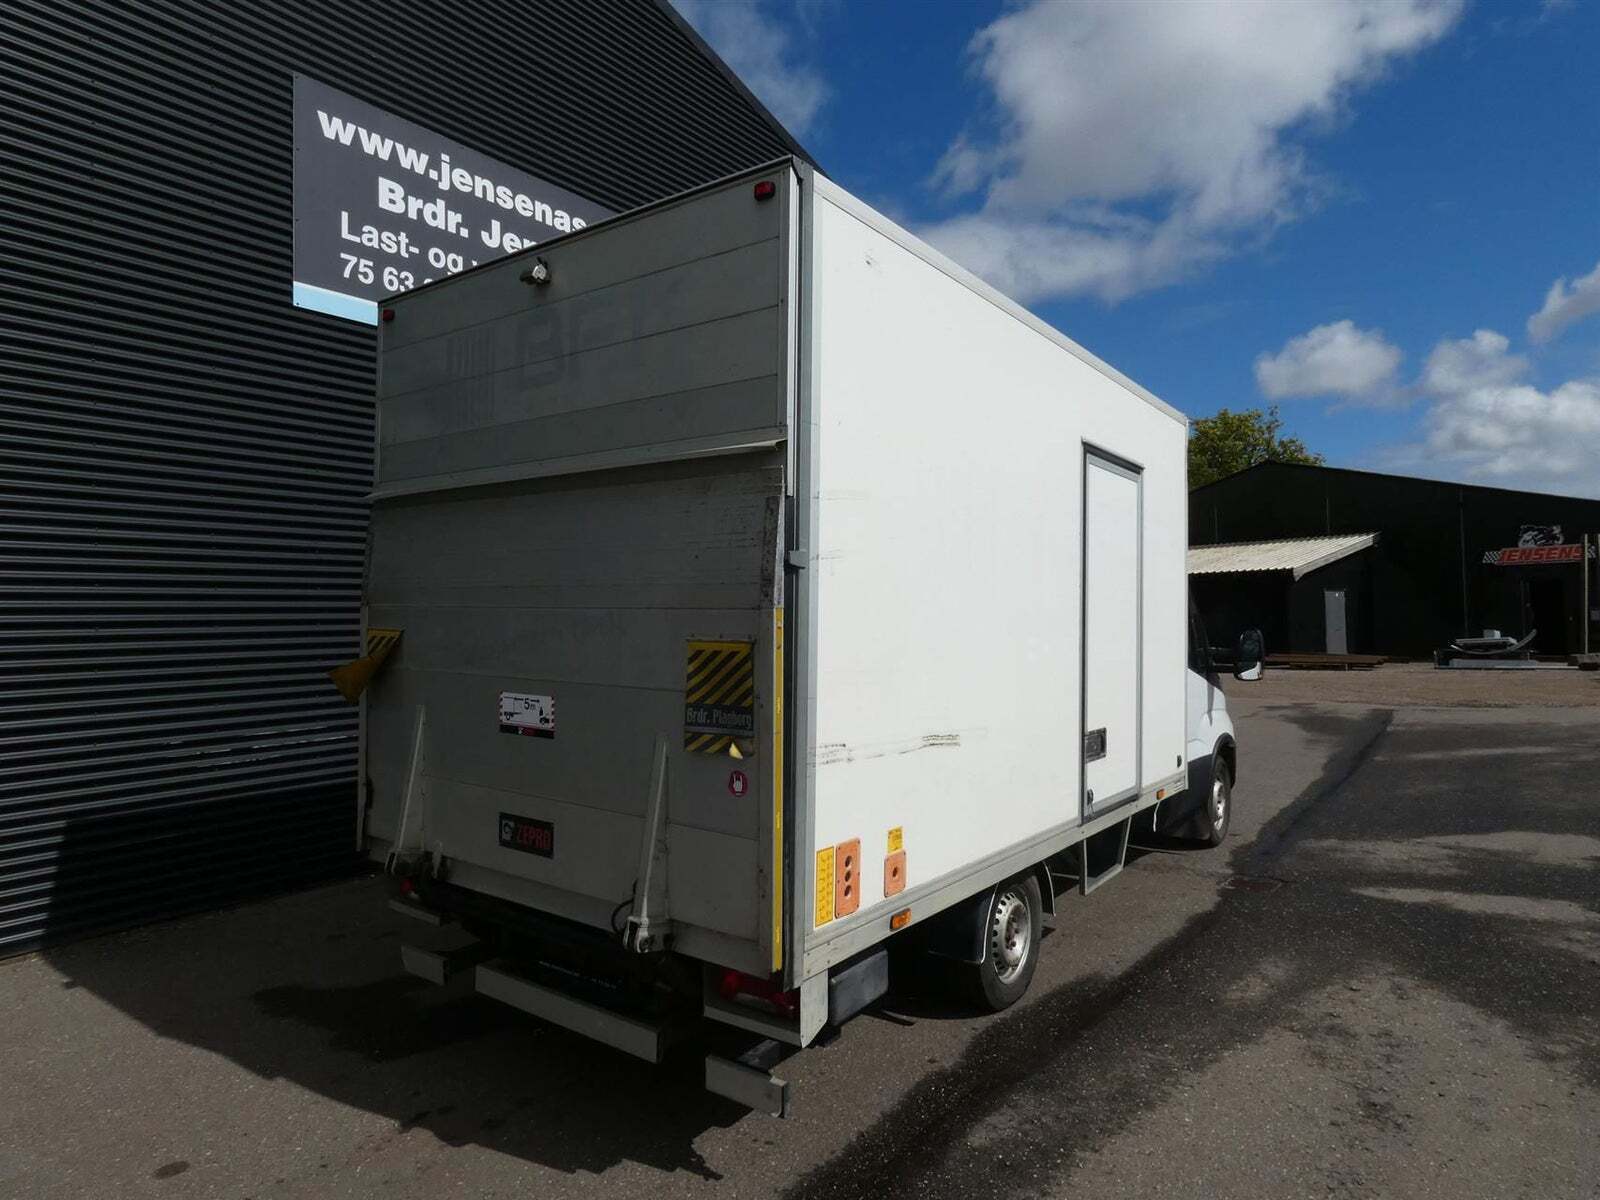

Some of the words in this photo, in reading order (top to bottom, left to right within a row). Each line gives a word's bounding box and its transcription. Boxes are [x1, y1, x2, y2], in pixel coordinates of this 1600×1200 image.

[377, 176, 470, 238] Brdr.
[340, 210, 420, 258] Last-
[427, 247, 463, 276] og
[339, 252, 375, 285] 75
[382, 266, 415, 292] 63
[686, 706, 710, 725] Brdr.
